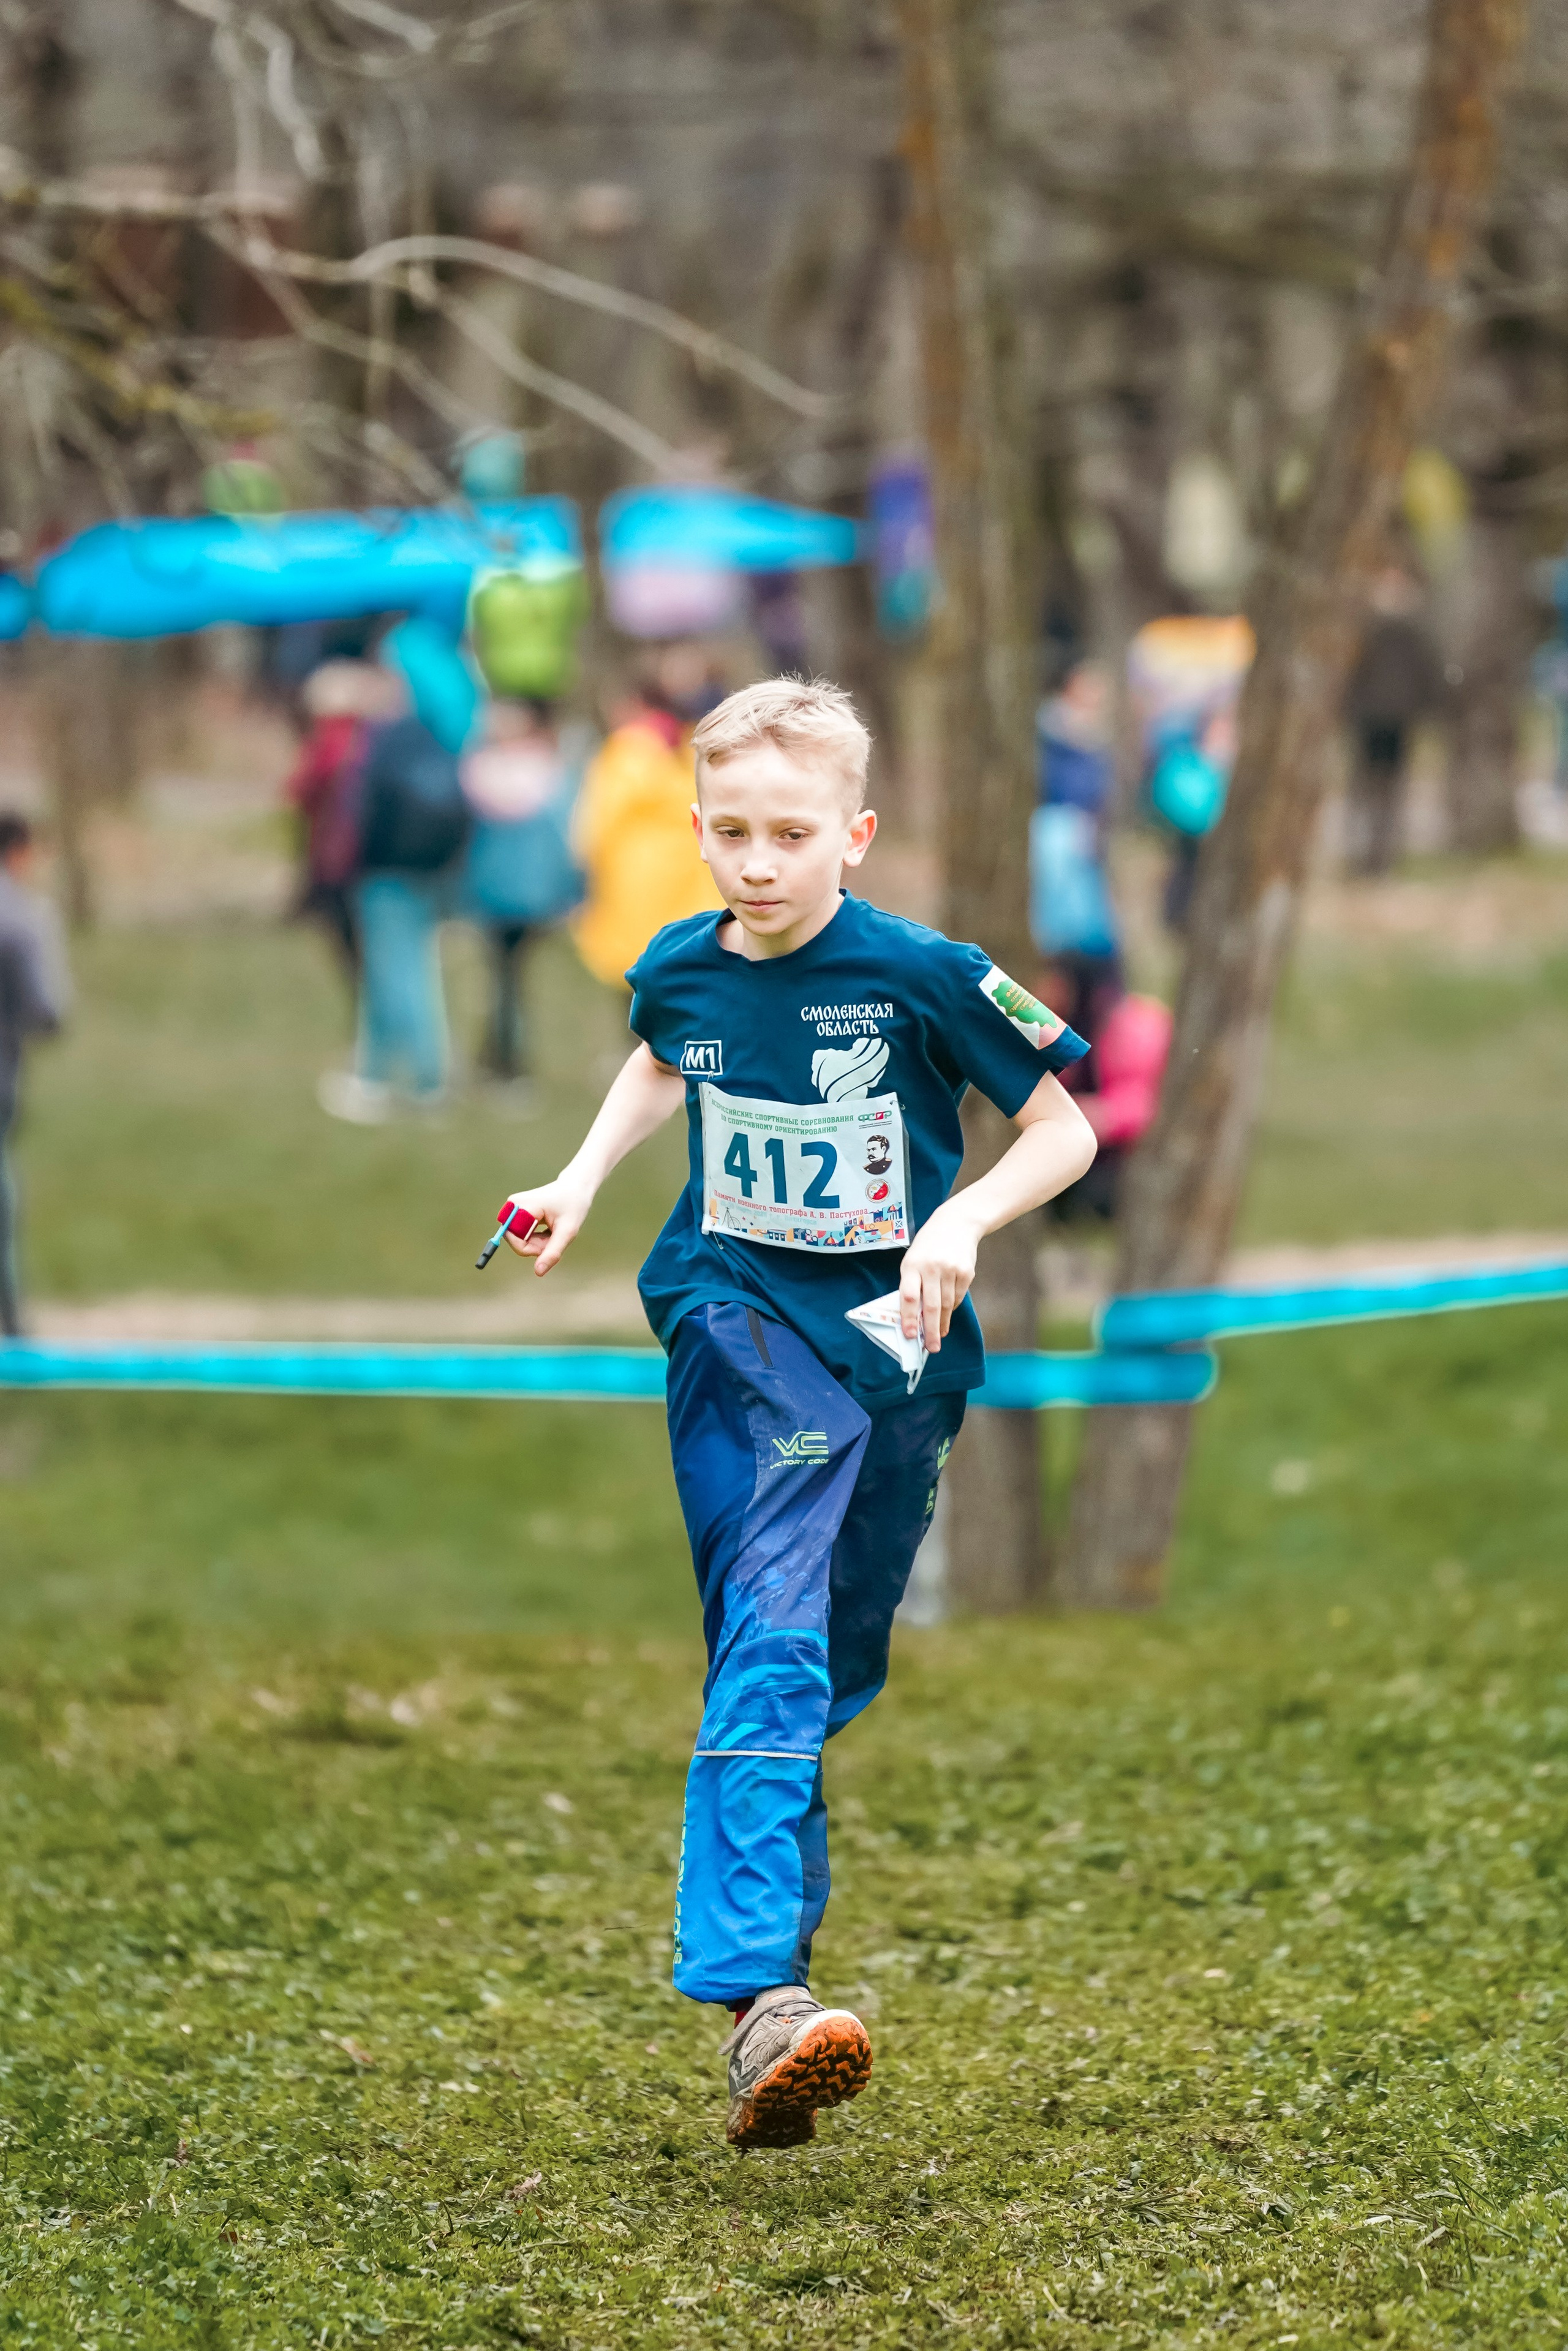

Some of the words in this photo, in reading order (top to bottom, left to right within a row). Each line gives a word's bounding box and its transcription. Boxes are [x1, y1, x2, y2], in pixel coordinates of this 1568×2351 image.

[801, 1003, 894, 1021] СМОЛЕНСКАЯ
[816, 1020, 879, 1036] ОБЛАСТЬ
[728, 1117, 772, 1130] СПОРТИВНОМУ
[775, 1125, 837, 1135] ОРИЕНТИРОВАНИЮ
[755, 1113, 798, 1125] СПОРТИВНЫЕ
[801, 1115, 854, 1126] СОРЕВНОВАНИЯ
[724, 1132, 840, 1209] 412
[738, 1198, 766, 1210] военного
[769, 1206, 807, 1217] топографа
[830, 1209, 869, 1219] Пастухова
[770, 1459, 805, 1469] VICTORY
